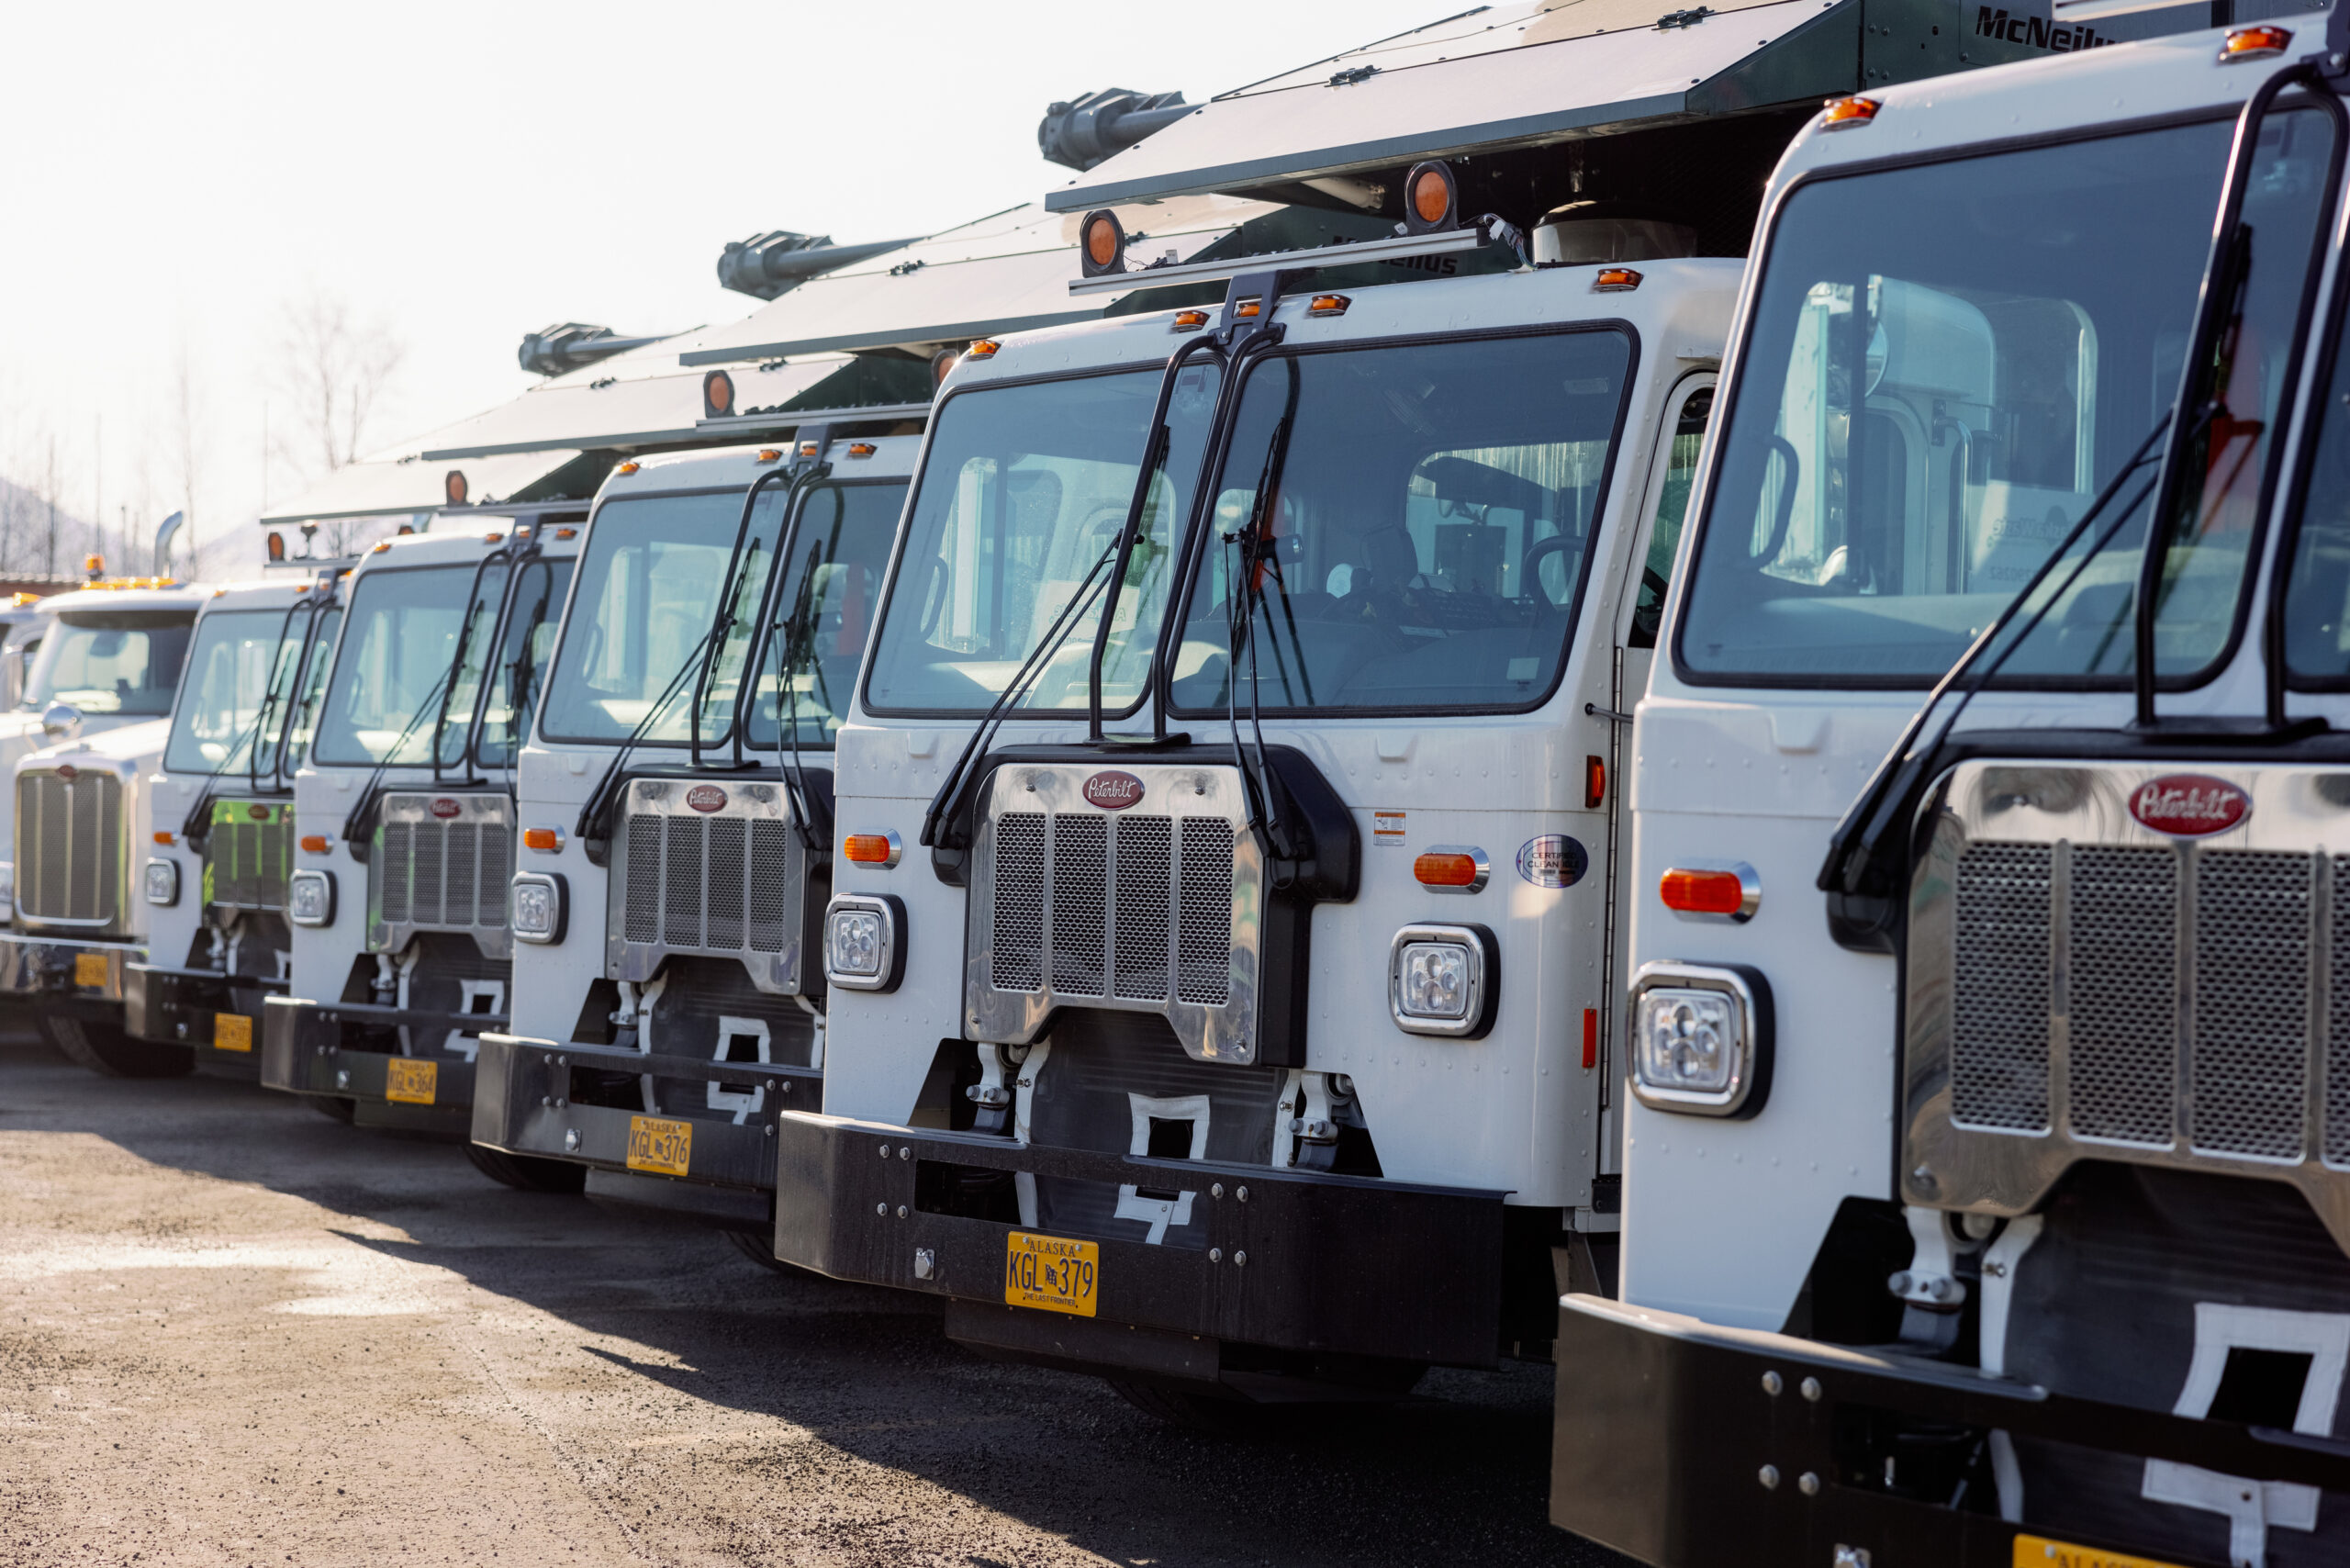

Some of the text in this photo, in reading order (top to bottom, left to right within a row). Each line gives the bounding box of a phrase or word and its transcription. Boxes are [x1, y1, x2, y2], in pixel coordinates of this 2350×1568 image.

[1975, 6, 2122, 52] McNeil
[1089, 778, 1136, 800] Peterbilt
[2137, 783, 2239, 820] Peterbilt
[1528, 860, 1560, 868] CLEAN
[630, 1130, 653, 1159] KGL
[663, 1134, 688, 1164] 376
[1029, 1240, 1076, 1258] ALASKA
[1009, 1250, 1093, 1298] KGL 379
[1035, 1294, 1049, 1303] LAST
[1050, 1295, 1076, 1306] FRONTIER
